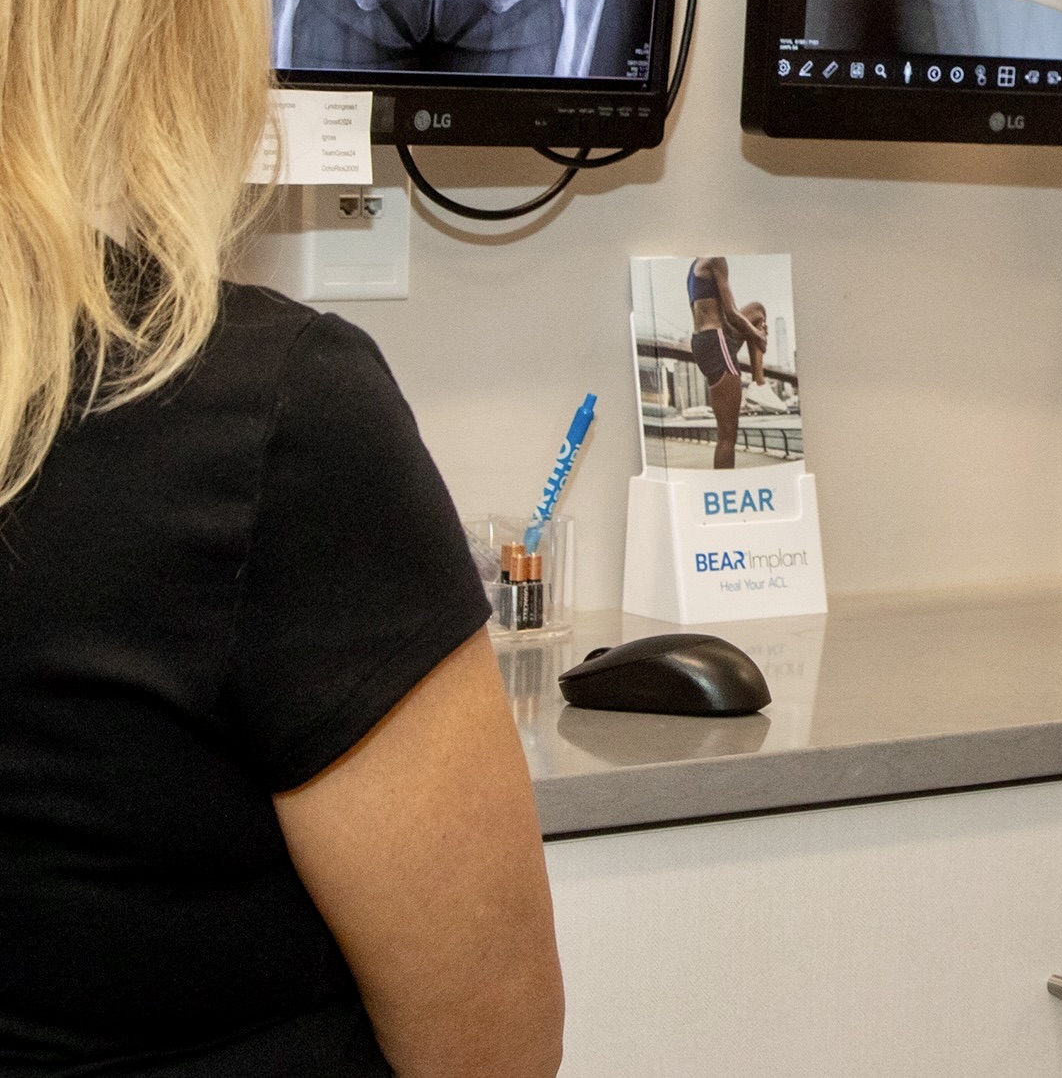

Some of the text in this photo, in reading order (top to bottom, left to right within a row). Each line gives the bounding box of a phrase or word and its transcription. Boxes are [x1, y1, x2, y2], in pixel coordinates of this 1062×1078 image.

[704, 488, 775, 515] BEAR
[720, 575, 789, 592] Heal Your ACL
